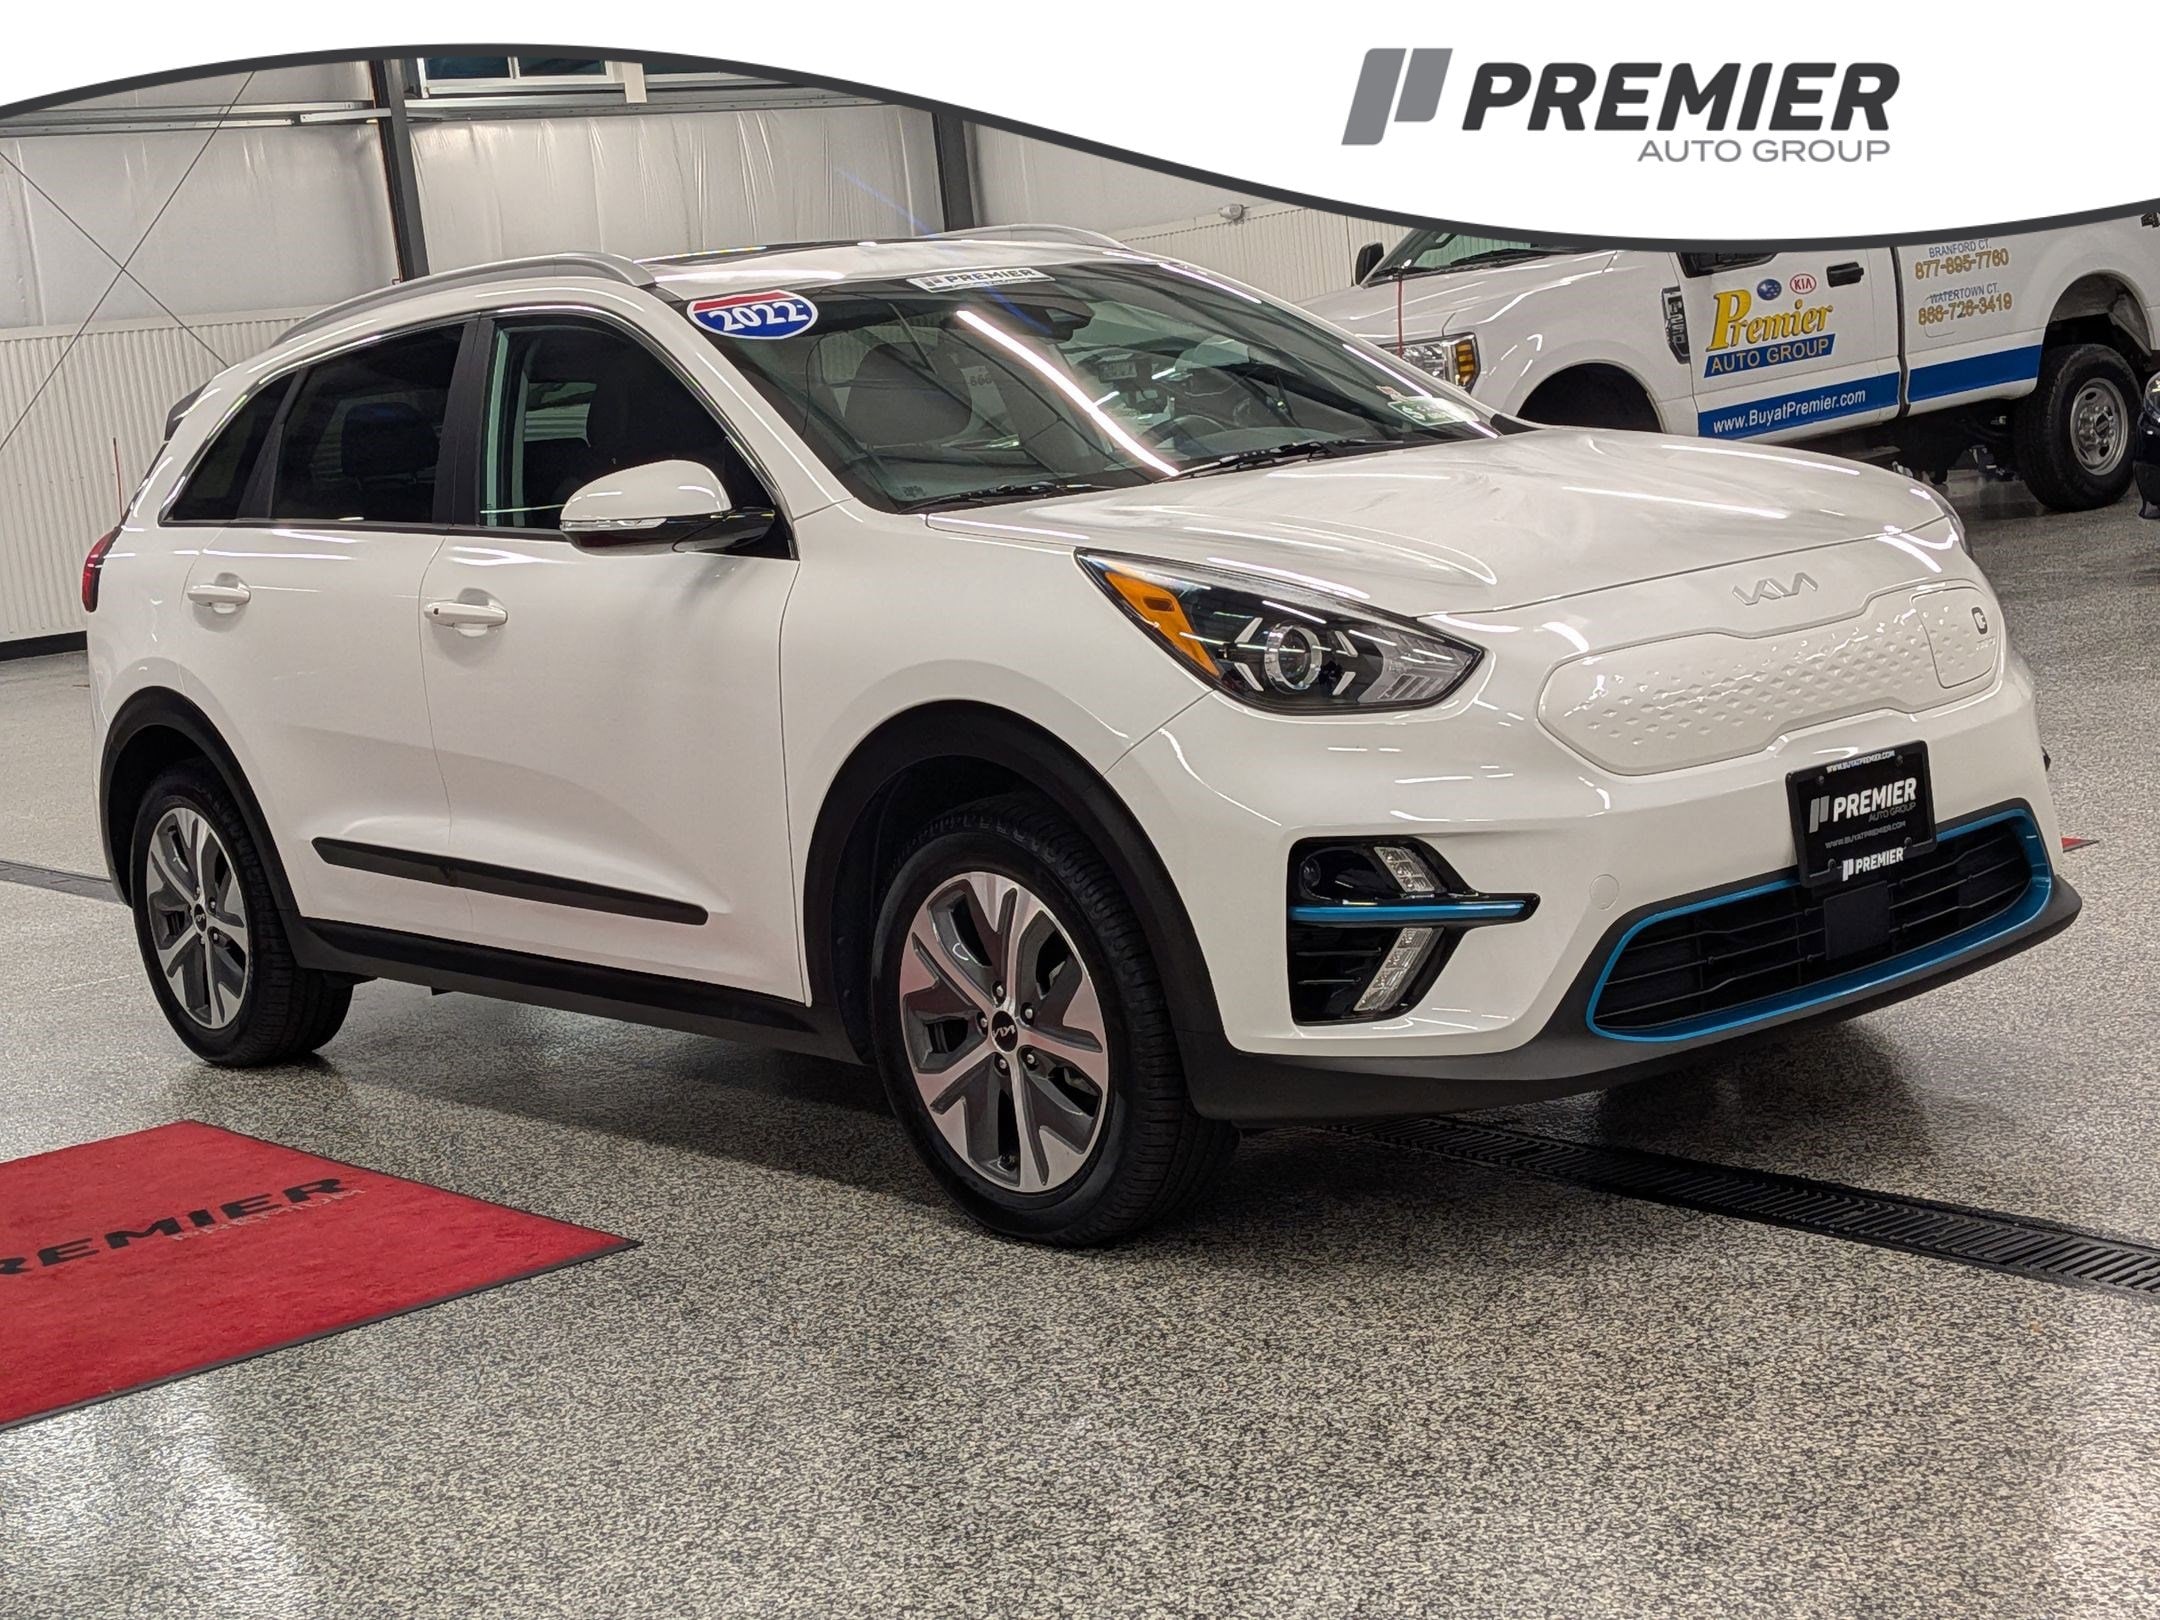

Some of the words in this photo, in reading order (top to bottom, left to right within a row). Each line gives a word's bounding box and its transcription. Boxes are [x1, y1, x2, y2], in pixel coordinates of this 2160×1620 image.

[1928, 241, 1977, 258] BRANFORD
[945, 270, 1036, 283] PREMIER
[1794, 278, 1813, 290] KIA
[1930, 286, 1985, 305] WATERTOWN
[708, 301, 809, 331] 2022
[1706, 287, 1834, 352] Premier
[1711, 350, 1760, 374] AUTO
[1766, 338, 1829, 364] GROUP
[1713, 387, 1866, 433] www.BuyatPremier.com
[1832, 777, 1917, 822] PREMIER
[1868, 808, 1890, 823] AUTO
[1890, 801, 1917, 817] GROUP
[1855, 847, 1904, 875] PREMIER
